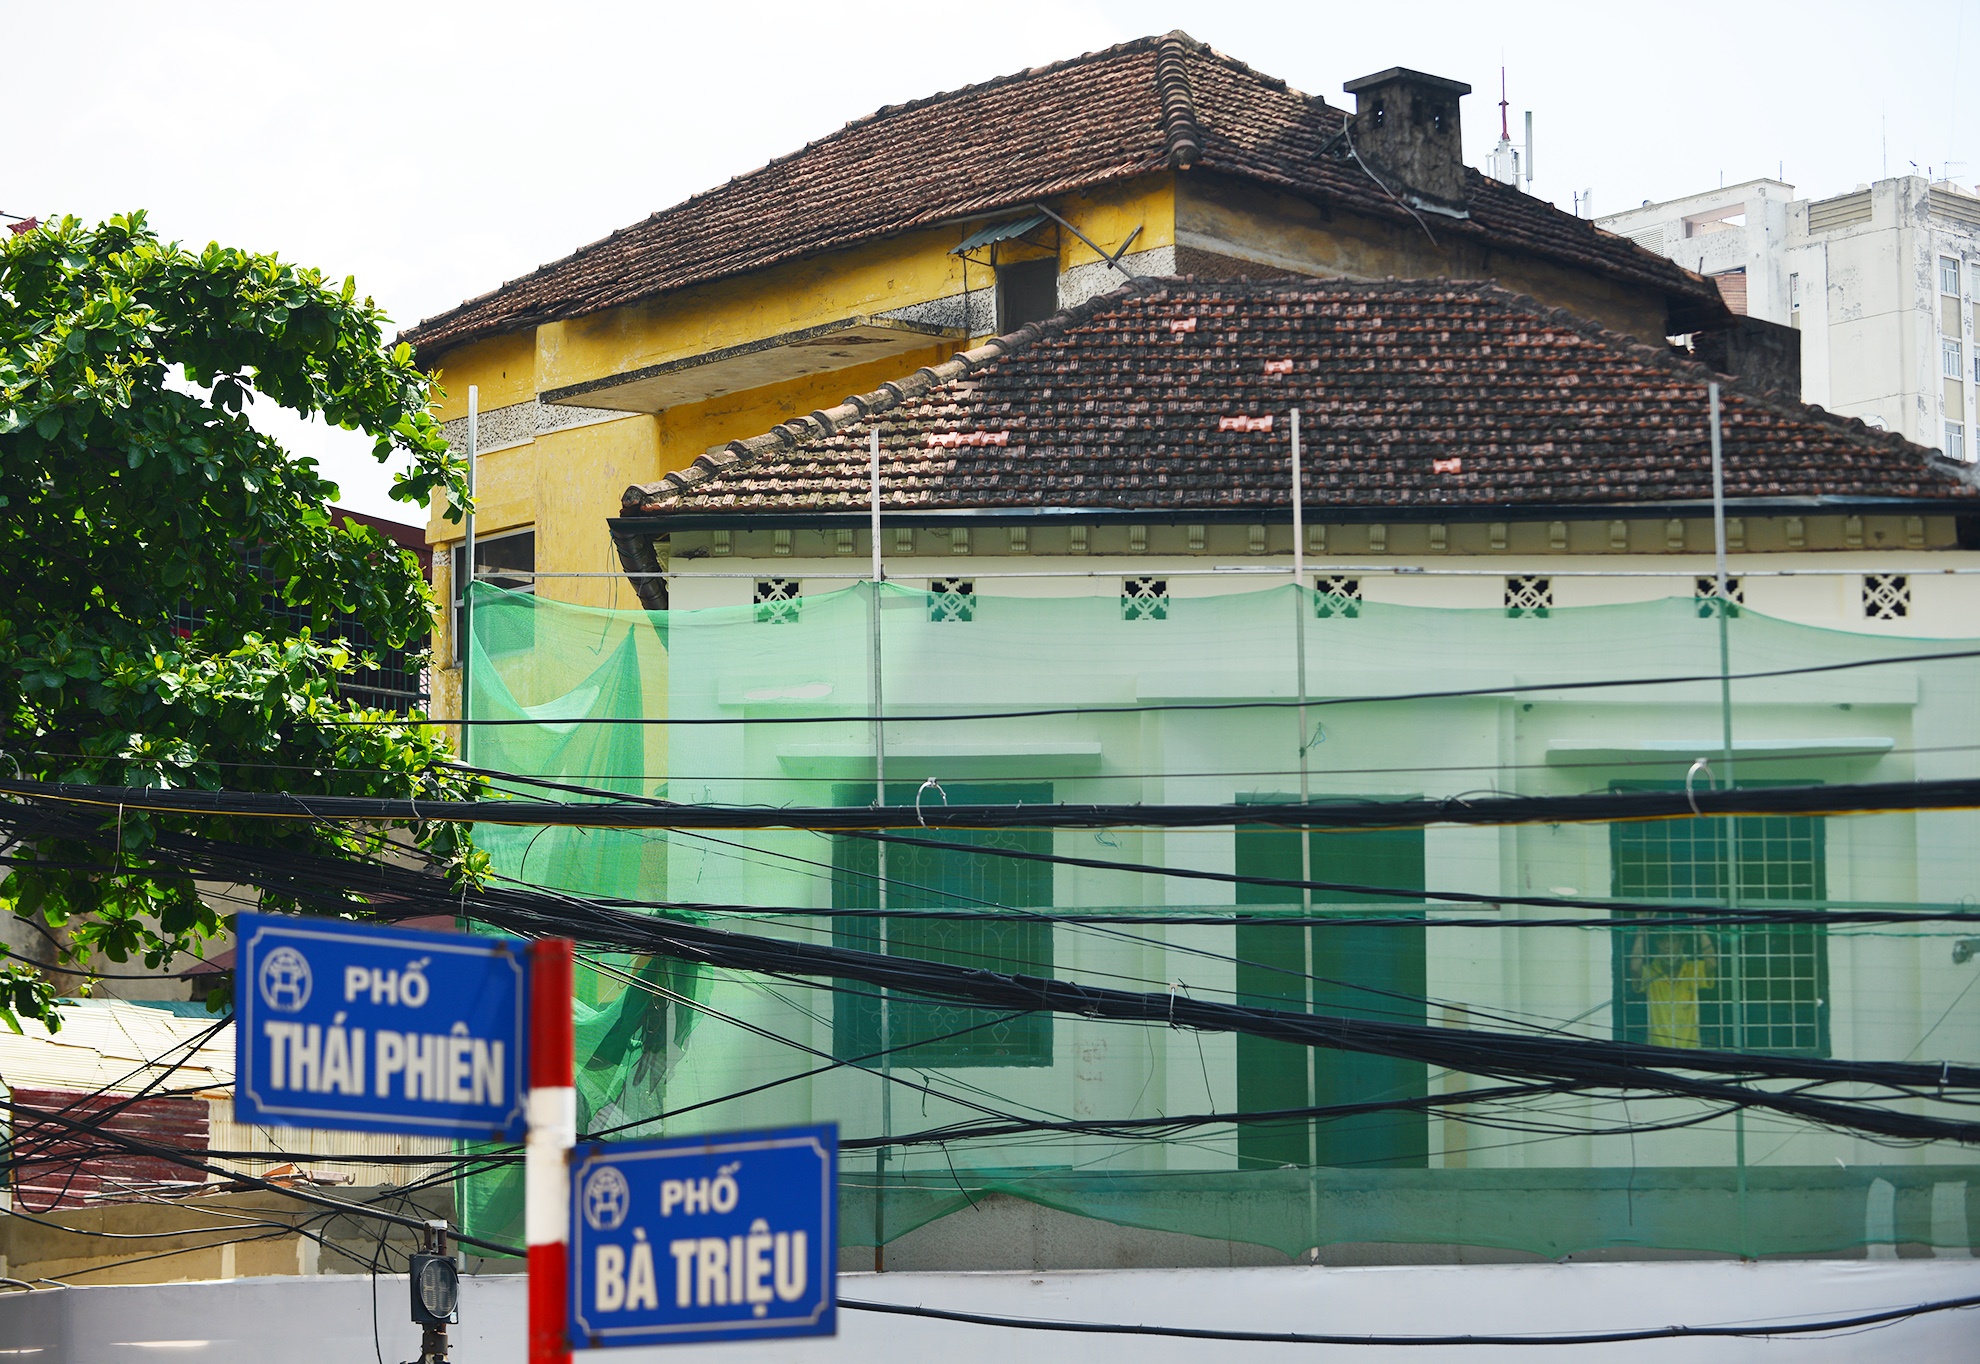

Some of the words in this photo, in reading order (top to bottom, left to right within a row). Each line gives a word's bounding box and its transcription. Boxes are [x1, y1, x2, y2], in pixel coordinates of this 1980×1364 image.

[345, 958, 430, 1008] PHỐ
[264, 1011, 366, 1096] THÁI
[375, 1021, 505, 1106] PHIÊN
[661, 1162, 740, 1217] PHỐ
[595, 1227, 658, 1313] BÀ
[670, 1218, 807, 1317] TRIỆU
